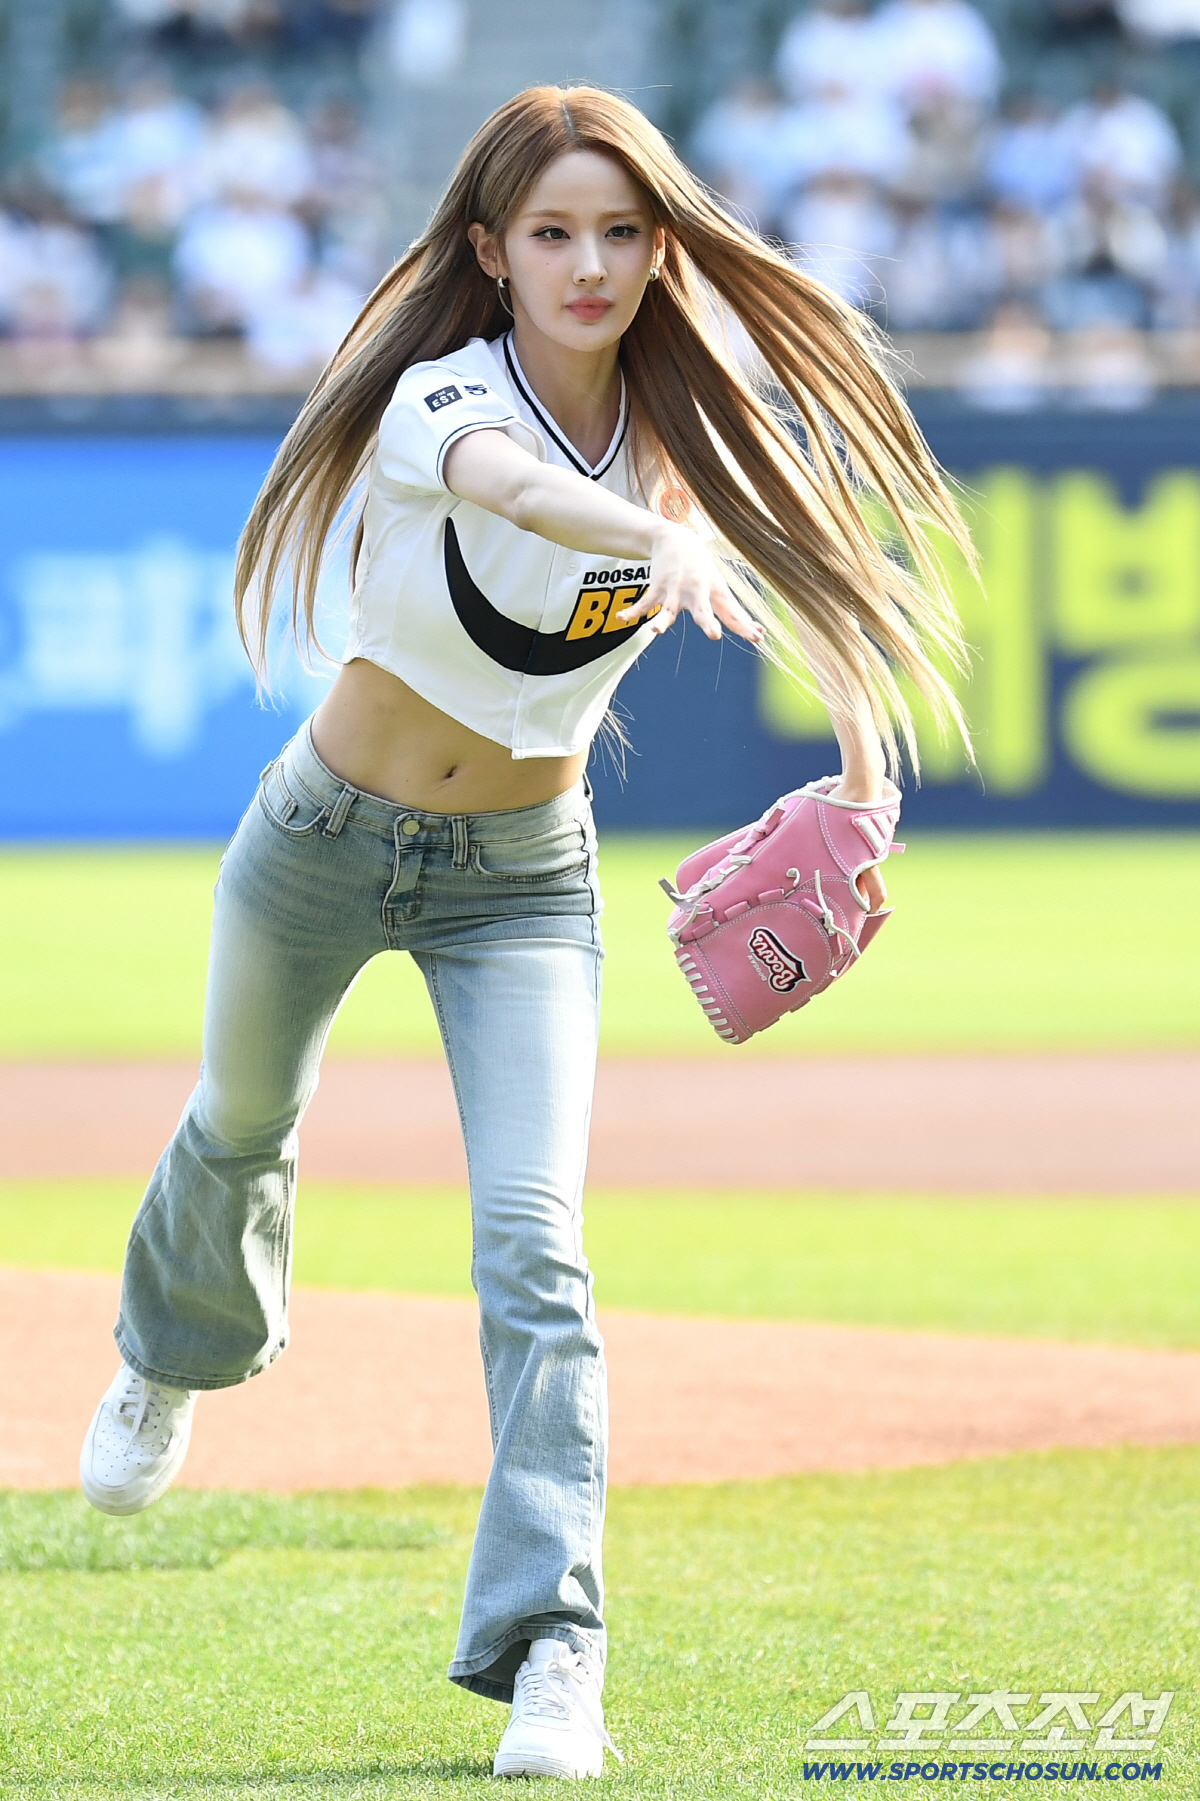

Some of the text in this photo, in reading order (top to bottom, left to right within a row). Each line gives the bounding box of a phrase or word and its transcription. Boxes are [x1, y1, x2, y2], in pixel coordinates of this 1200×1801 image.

[432, 391, 456, 408] EST
[582, 565, 652, 585] DOOSA
[747, 954, 767, 982] DOOSAN
[751, 930, 799, 991] Bears
